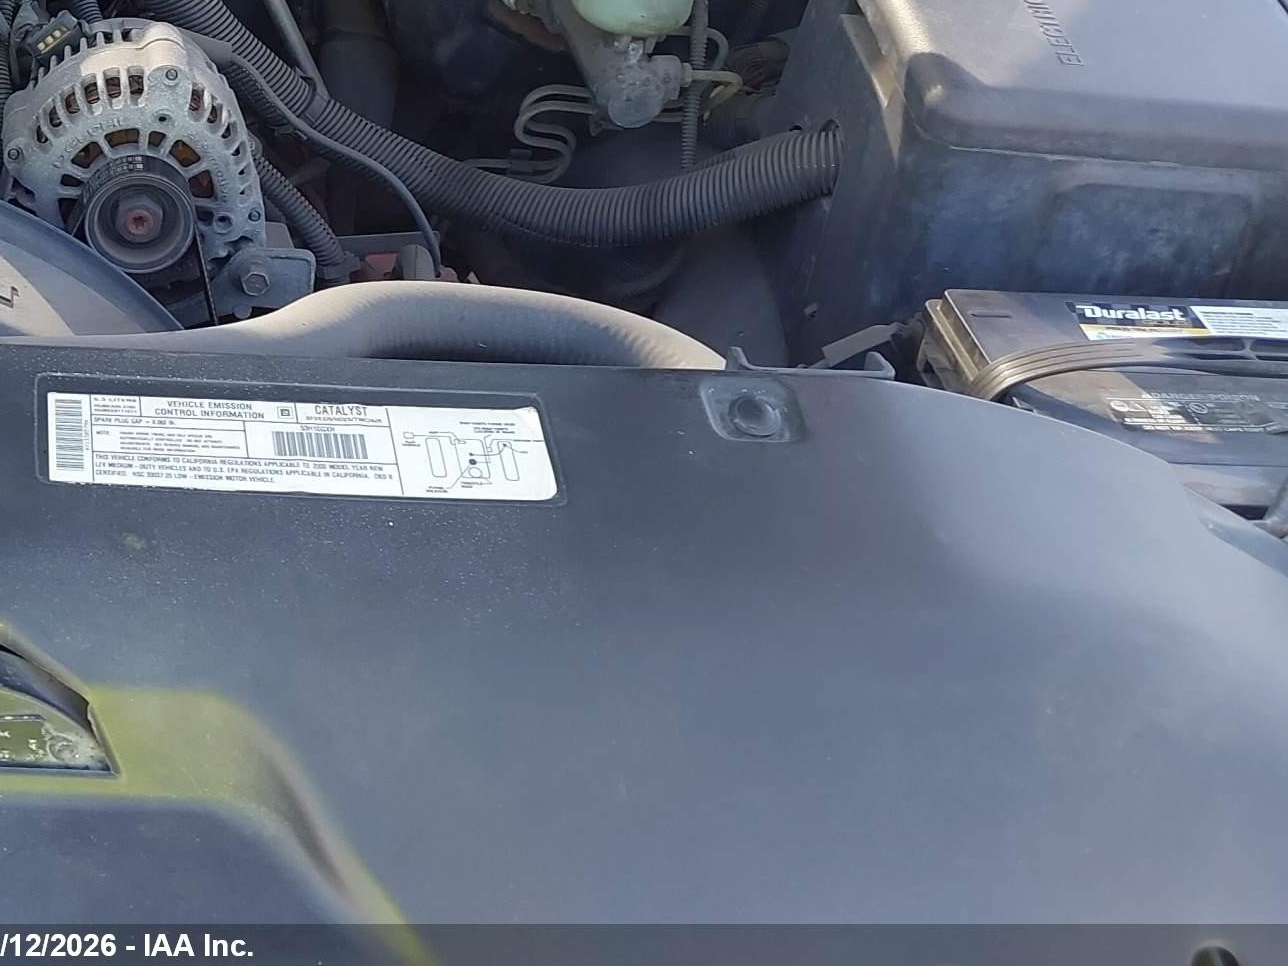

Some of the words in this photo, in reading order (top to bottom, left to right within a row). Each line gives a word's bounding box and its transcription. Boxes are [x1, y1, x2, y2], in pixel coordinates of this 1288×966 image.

[1075, 305, 1185, 322] Duralast
[167, 400, 204, 409] VEHICLE
[208, 401, 252, 410] EMISSION
[315, 405, 368, 416] CATALYST
[155, 408, 197, 417] CONTROL
[201, 410, 265, 419] INFORMATION
